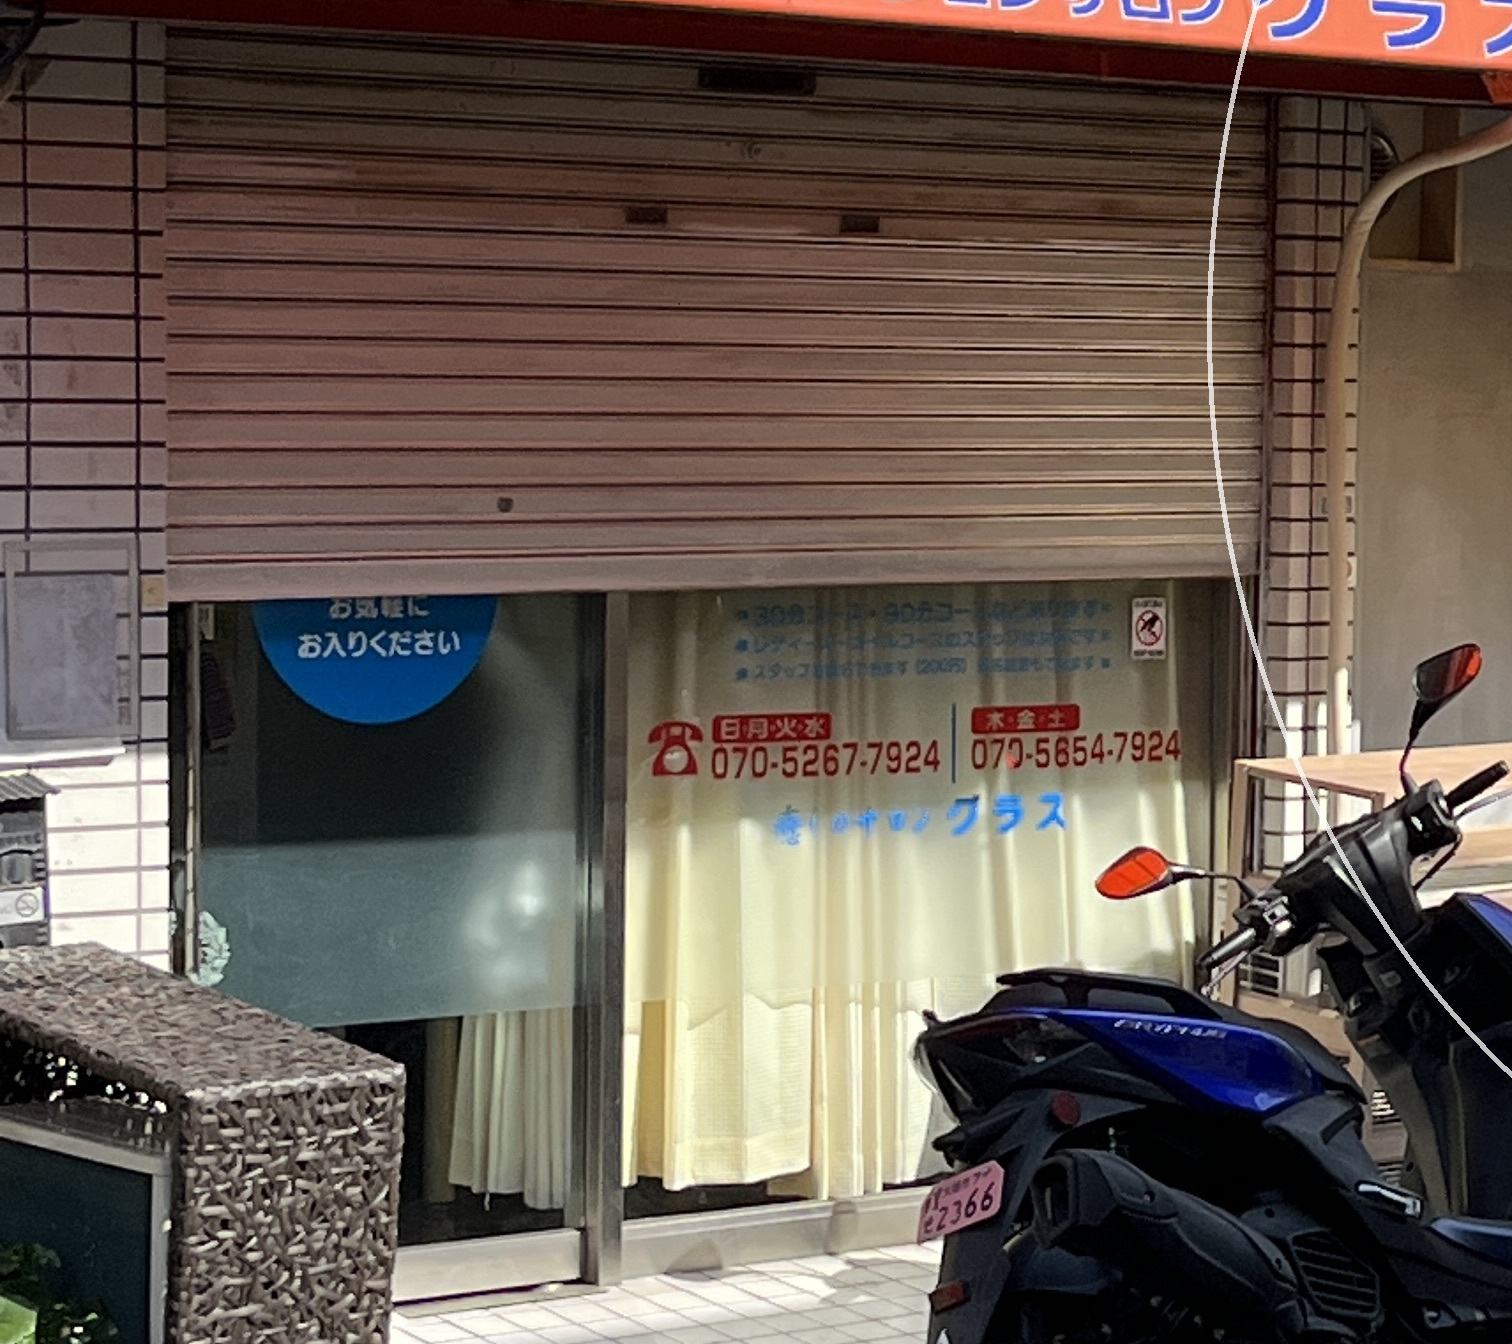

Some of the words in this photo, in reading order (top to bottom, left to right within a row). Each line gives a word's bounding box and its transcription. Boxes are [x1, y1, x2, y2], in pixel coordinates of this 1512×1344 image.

[298, 630, 462, 660] お入りください
[712, 739, 940, 779] 070-5267-7924
[971, 729, 1181, 770] 070-5654-7924
[947, 791, 1067, 837] グラス
[936, 1182, 995, 1232] 2366
